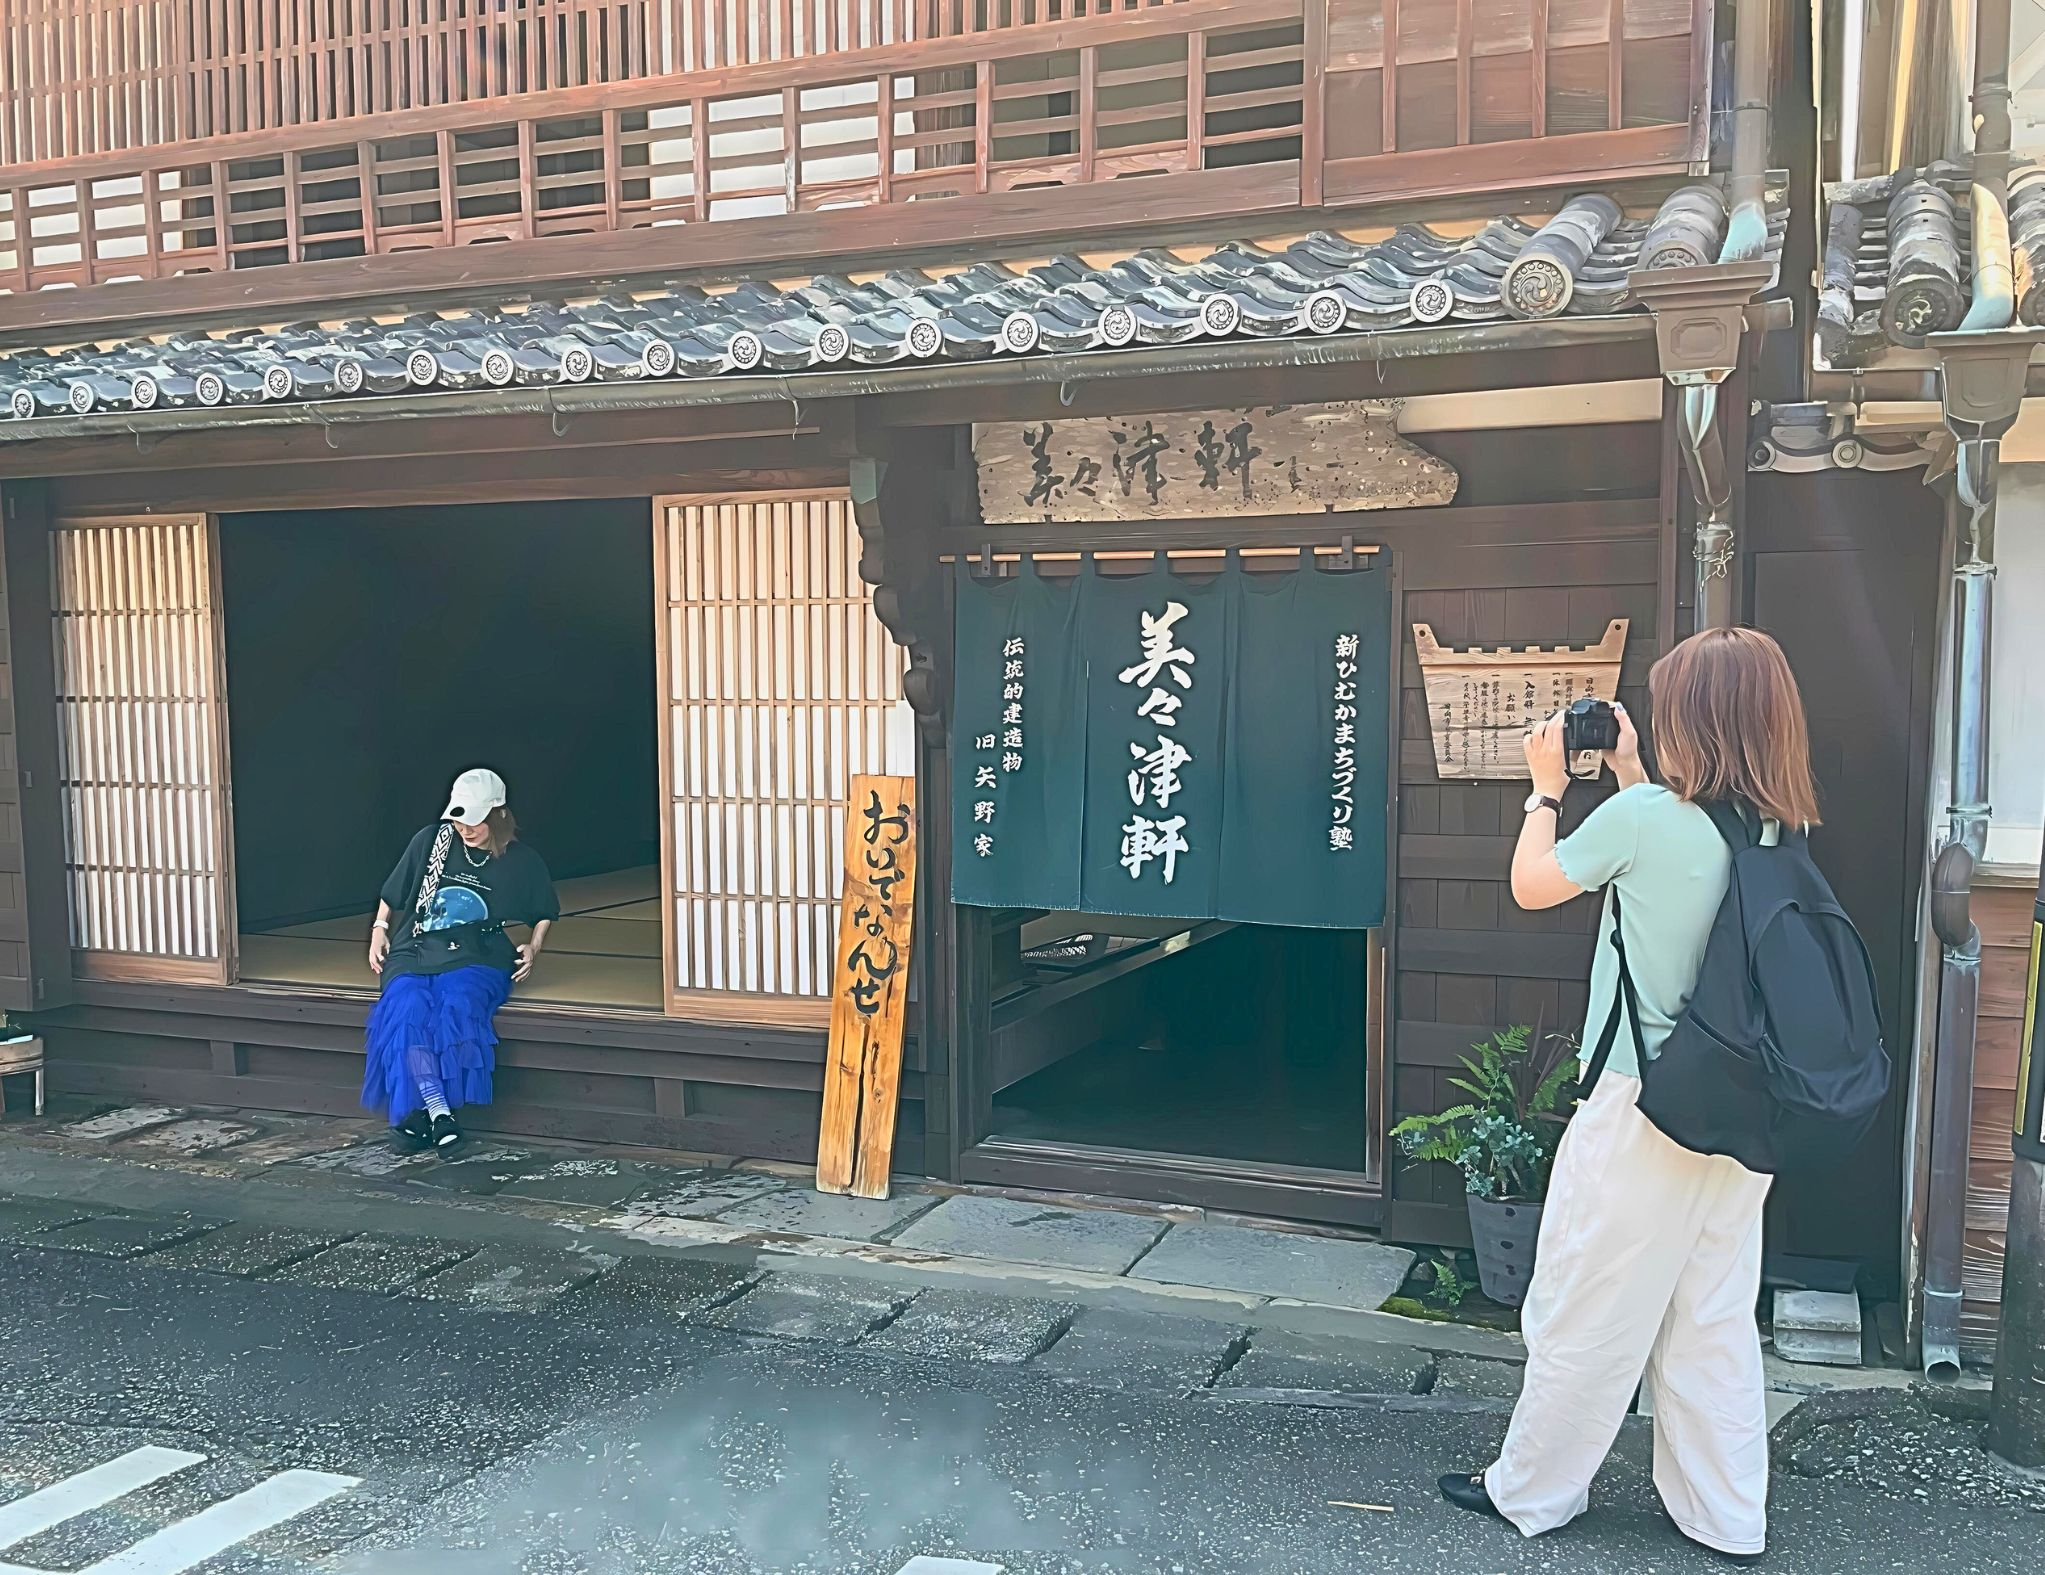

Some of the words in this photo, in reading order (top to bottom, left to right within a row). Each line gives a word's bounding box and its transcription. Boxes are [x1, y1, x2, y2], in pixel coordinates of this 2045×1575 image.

[974, 733, 997, 858] 旧矢野家
[1002, 636, 1025, 773] 伝統的建造物
[1118, 601, 1195, 885] 美々津軒
[1329, 633, 1360, 851] 新ひむかまちづくり塾
[847, 789, 911, 1017] おいでなんせ
